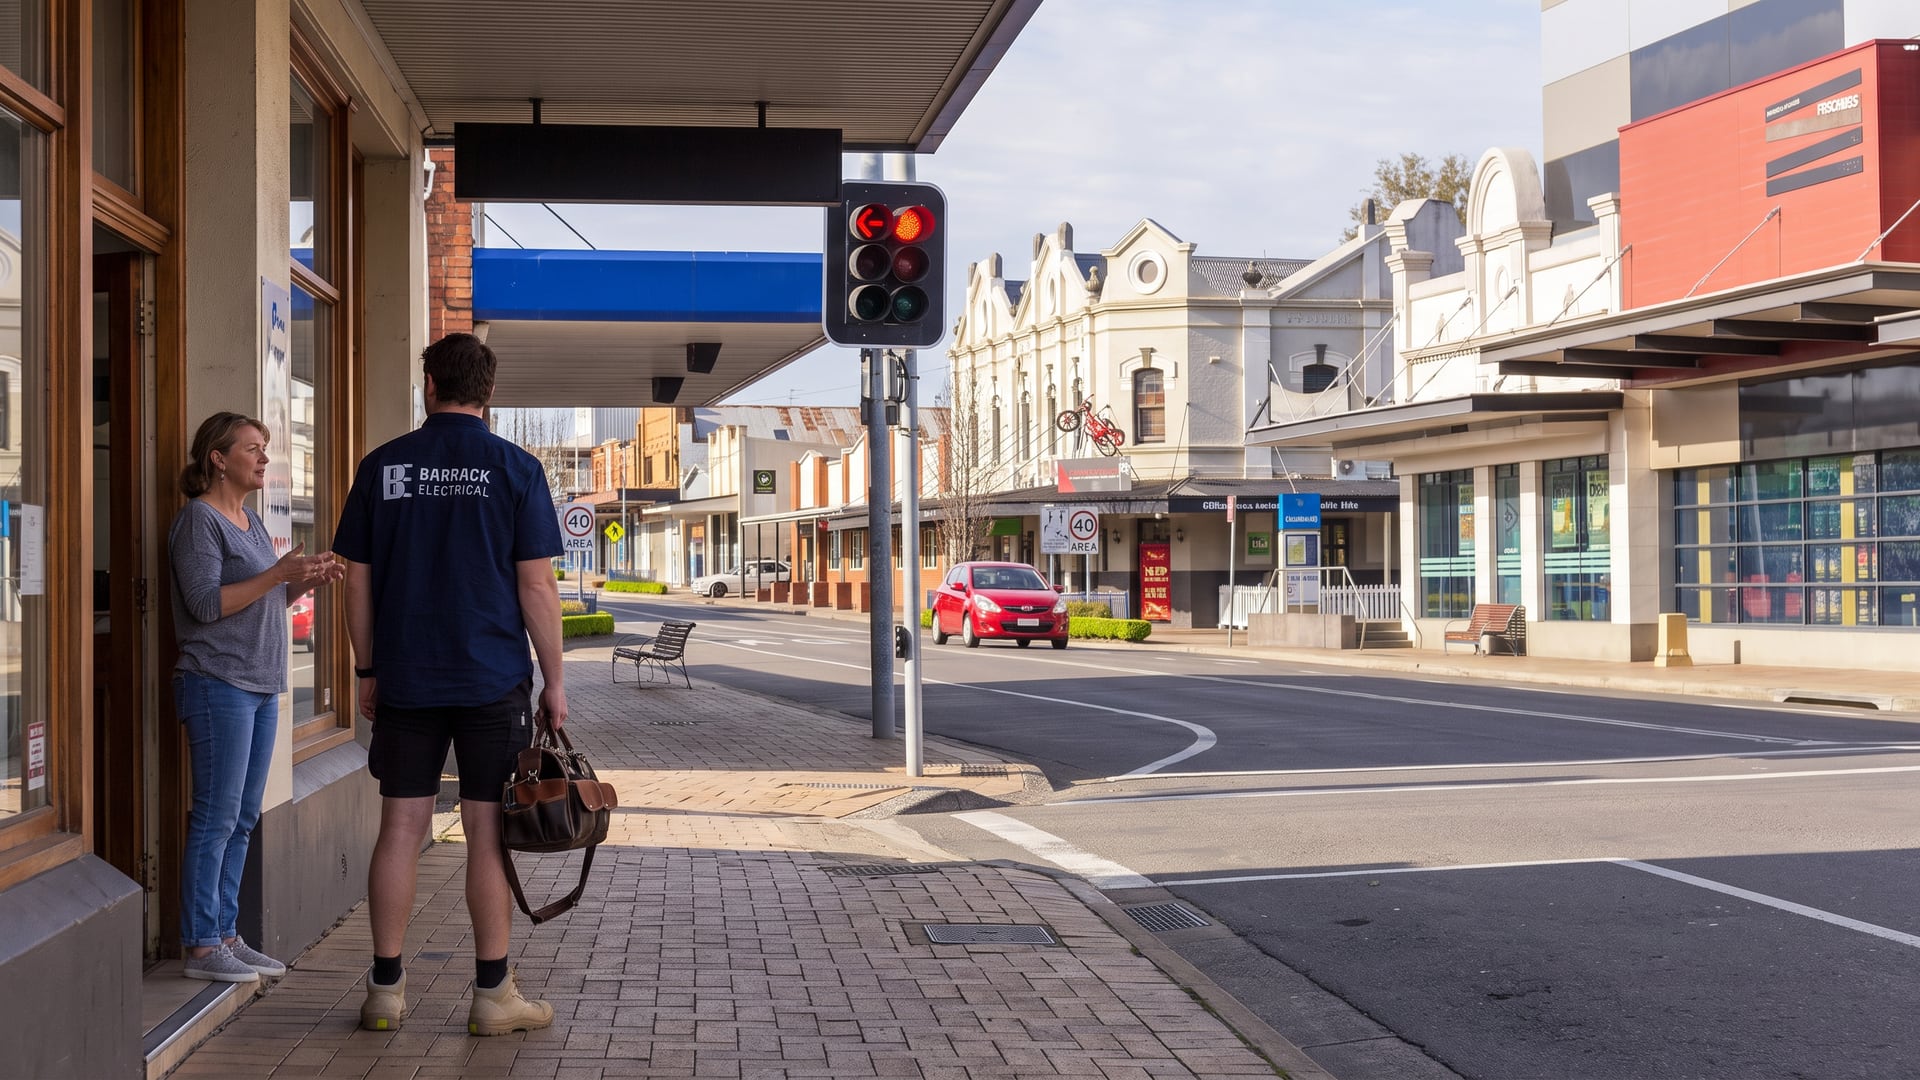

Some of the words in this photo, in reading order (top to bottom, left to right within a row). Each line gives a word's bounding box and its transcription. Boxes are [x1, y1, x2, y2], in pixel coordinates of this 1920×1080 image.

[420, 468, 491, 484] BARRACK
[419, 485, 489, 498] ELECTRICAL
[568, 514, 590, 528] 40
[1073, 519, 1094, 532] 40
[566, 540, 593, 548] AREA
[1071, 542, 1097, 551] AREA
